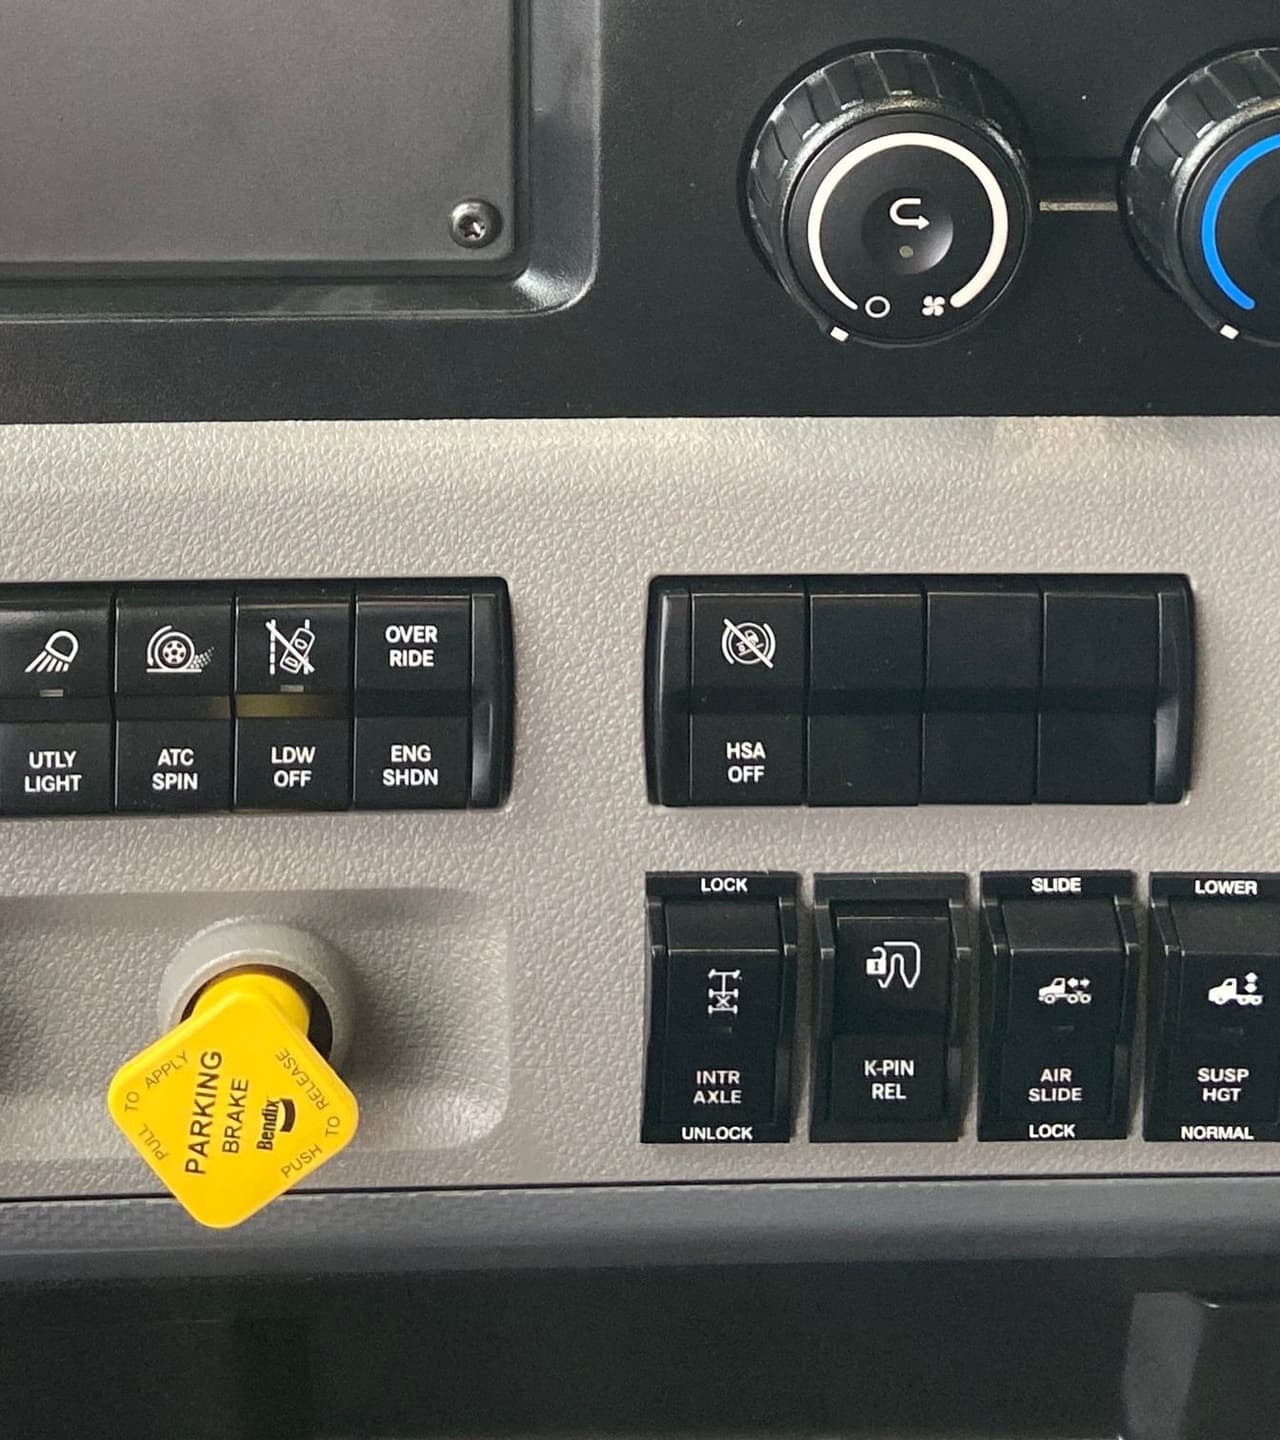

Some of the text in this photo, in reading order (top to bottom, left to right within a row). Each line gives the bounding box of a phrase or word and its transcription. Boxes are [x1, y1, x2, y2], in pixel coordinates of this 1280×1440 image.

[385, 626, 438, 644] OVER
[389, 650, 435, 668] RIDE
[158, 748, 194, 766] ATC
[271, 747, 316, 764] LDW
[390, 745, 432, 763] ENG
[726, 742, 766, 760] HSA
[29, 751, 77, 769] UTLY
[24, 774, 82, 792] LIGHT
[152, 772, 198, 790] SPIN
[273, 770, 312, 788] OFF
[383, 768, 439, 786] SHDN
[728, 766, 765, 783] OFF
[700, 878, 748, 893] LOCK
[1031, 878, 1081, 892] SLIDE
[1195, 880, 1258, 895] LOWER
[695, 1071, 741, 1085] INTR
[864, 1061, 914, 1078] K-PIN
[1040, 1068, 1072, 1083] AIR
[1197, 1068, 1249, 1083] SUSP
[693, 1090, 742, 1105] AXLE
[871, 1084, 907, 1100] REL
[1028, 1087, 1082, 1102] SLIDE
[1202, 1087, 1242, 1102] HGT
[124, 1051, 189, 1161] PULL TO APPLY
[185, 1050, 222, 1175] PARKING
[274, 1047, 341, 1179] PUSH TO RELEASE
[222, 1078, 249, 1154] BRAKE
[256, 1098, 280, 1151] Bendix
[681, 1126, 753, 1141] UNLOCK
[1028, 1124, 1076, 1139] LOCK
[1180, 1126, 1254, 1141] NORMAL
